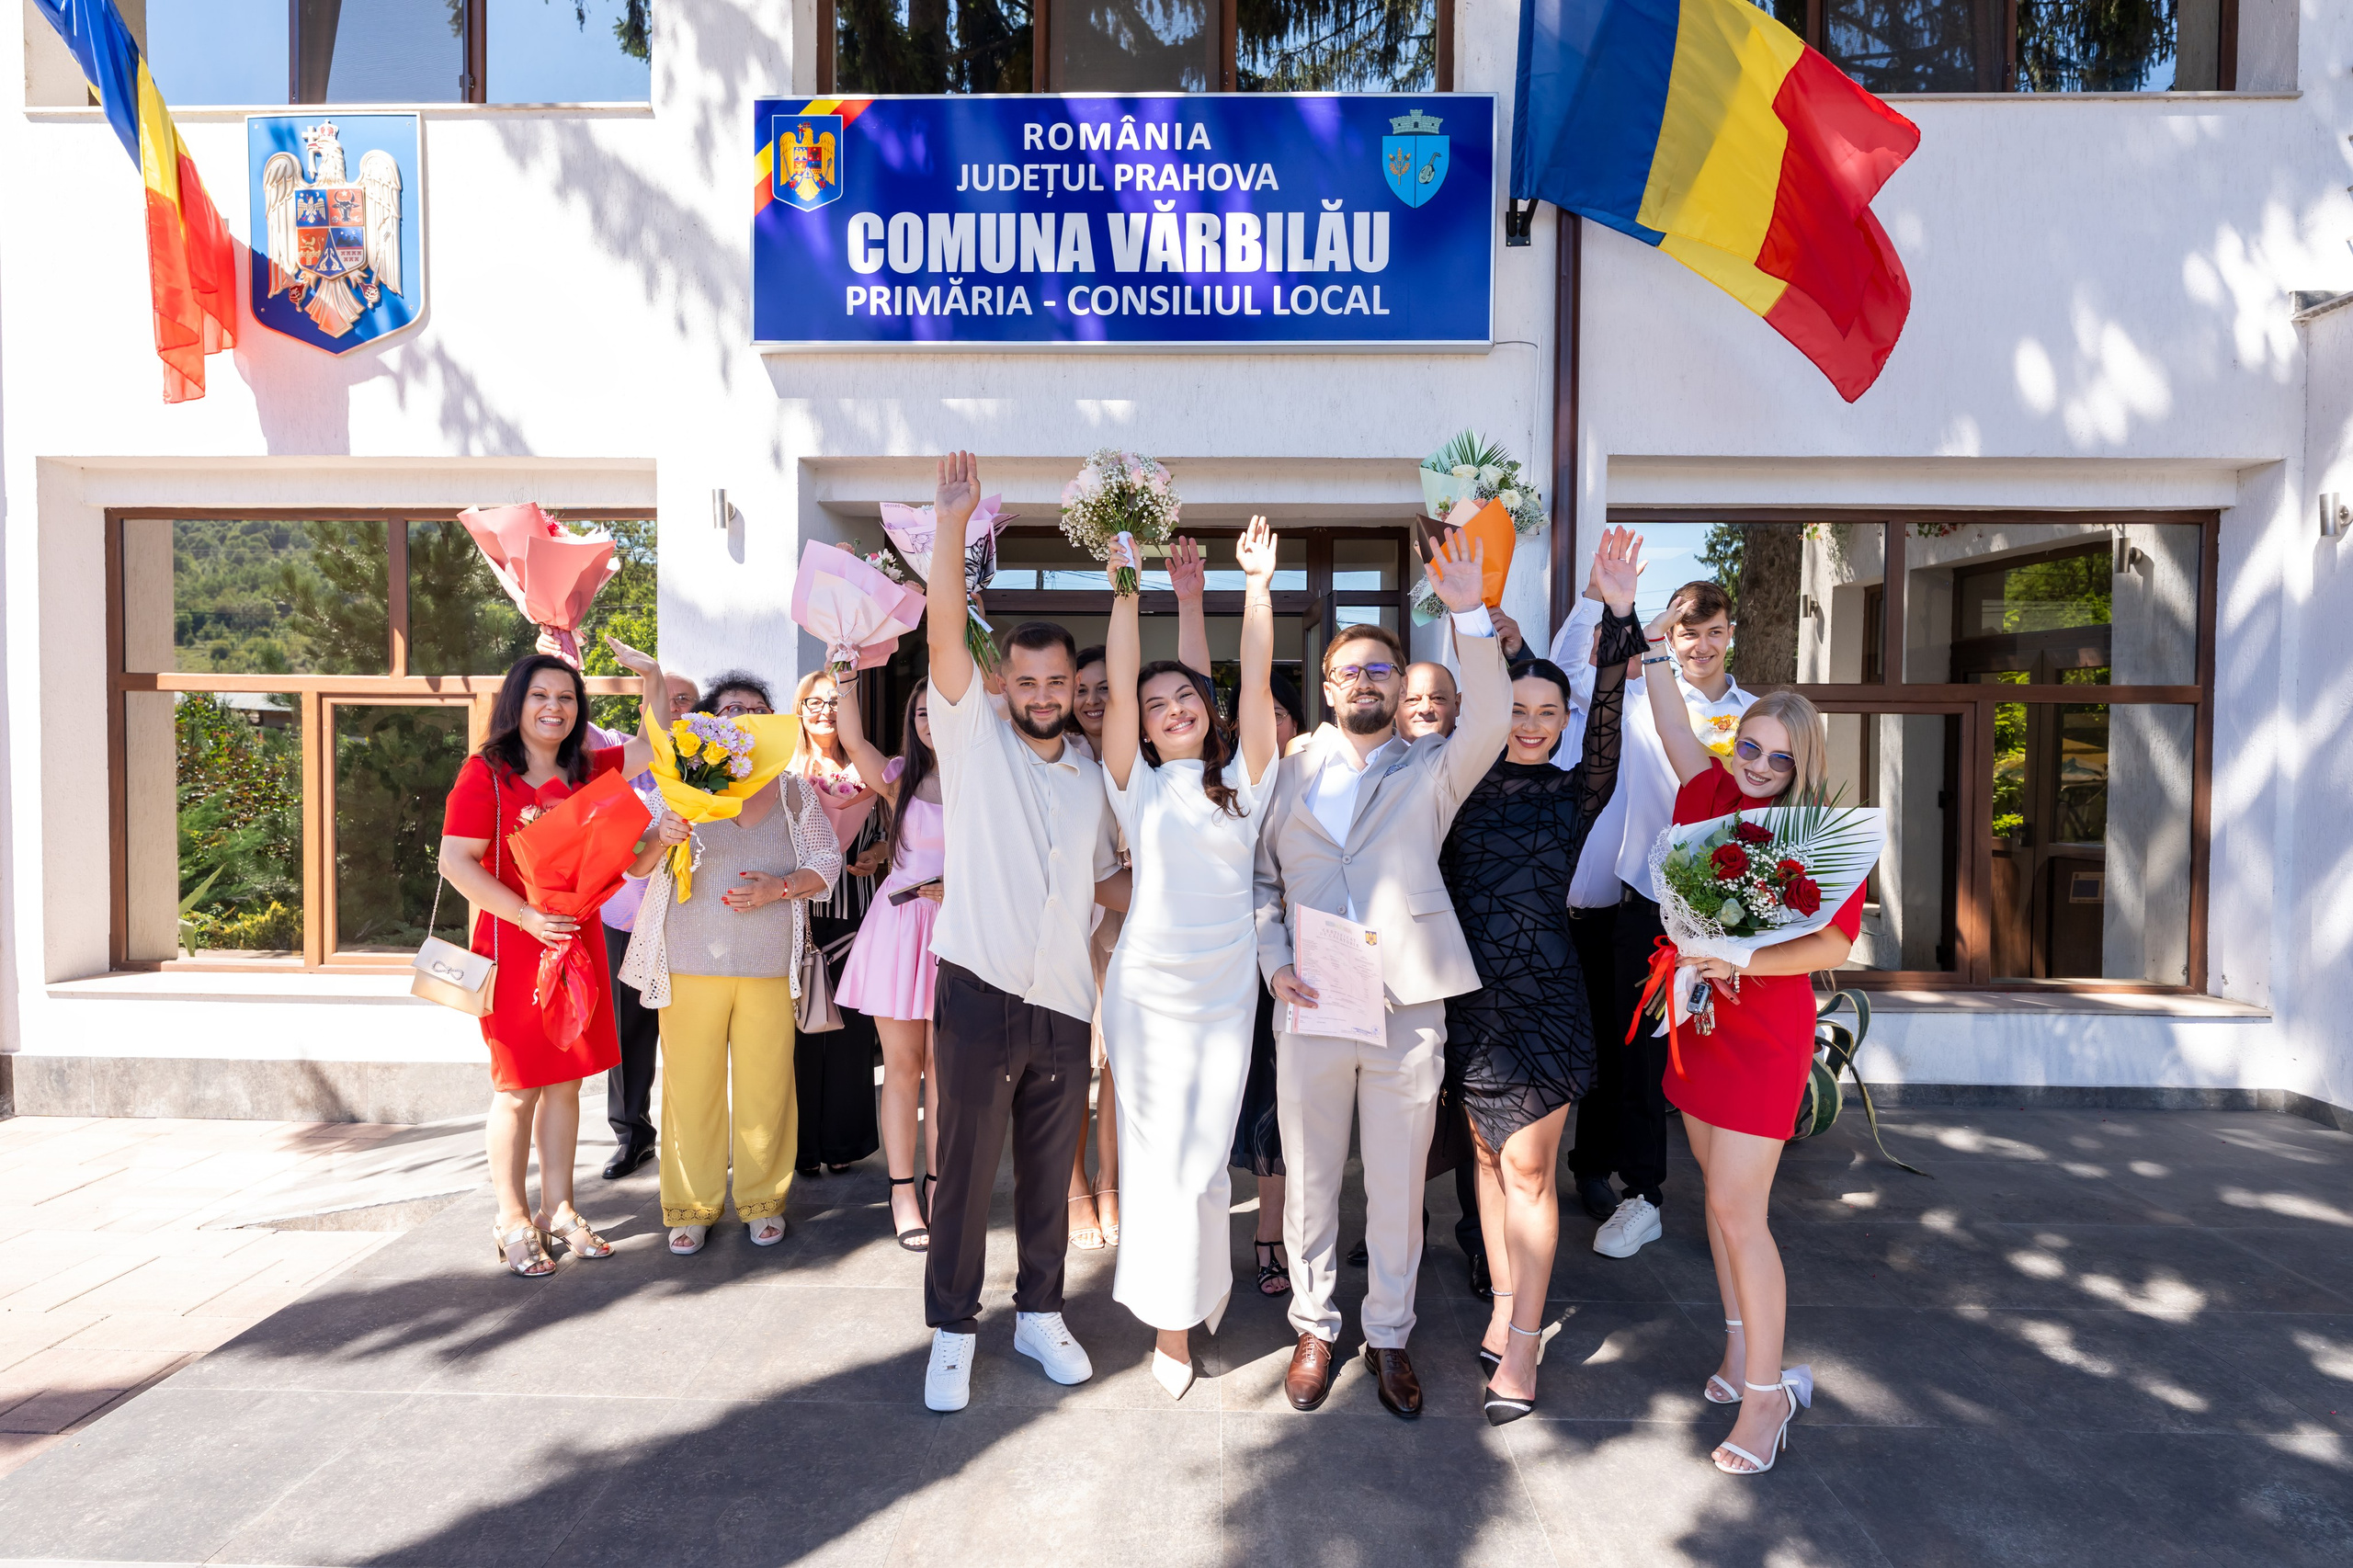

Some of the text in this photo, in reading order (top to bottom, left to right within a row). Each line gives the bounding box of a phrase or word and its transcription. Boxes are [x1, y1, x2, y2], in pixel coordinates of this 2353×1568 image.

[1025, 115, 1211, 150] ROMÂNIA
[957, 164, 1279, 198] JUDEȚUL PRAHOVA
[847, 199, 1389, 274] COMUNA VĂRBILĂU
[847, 278, 1032, 315] PRIMĂRIA
[1068, 286, 1261, 315] CONSILIUL
[1274, 286, 1389, 314] LOCAL
